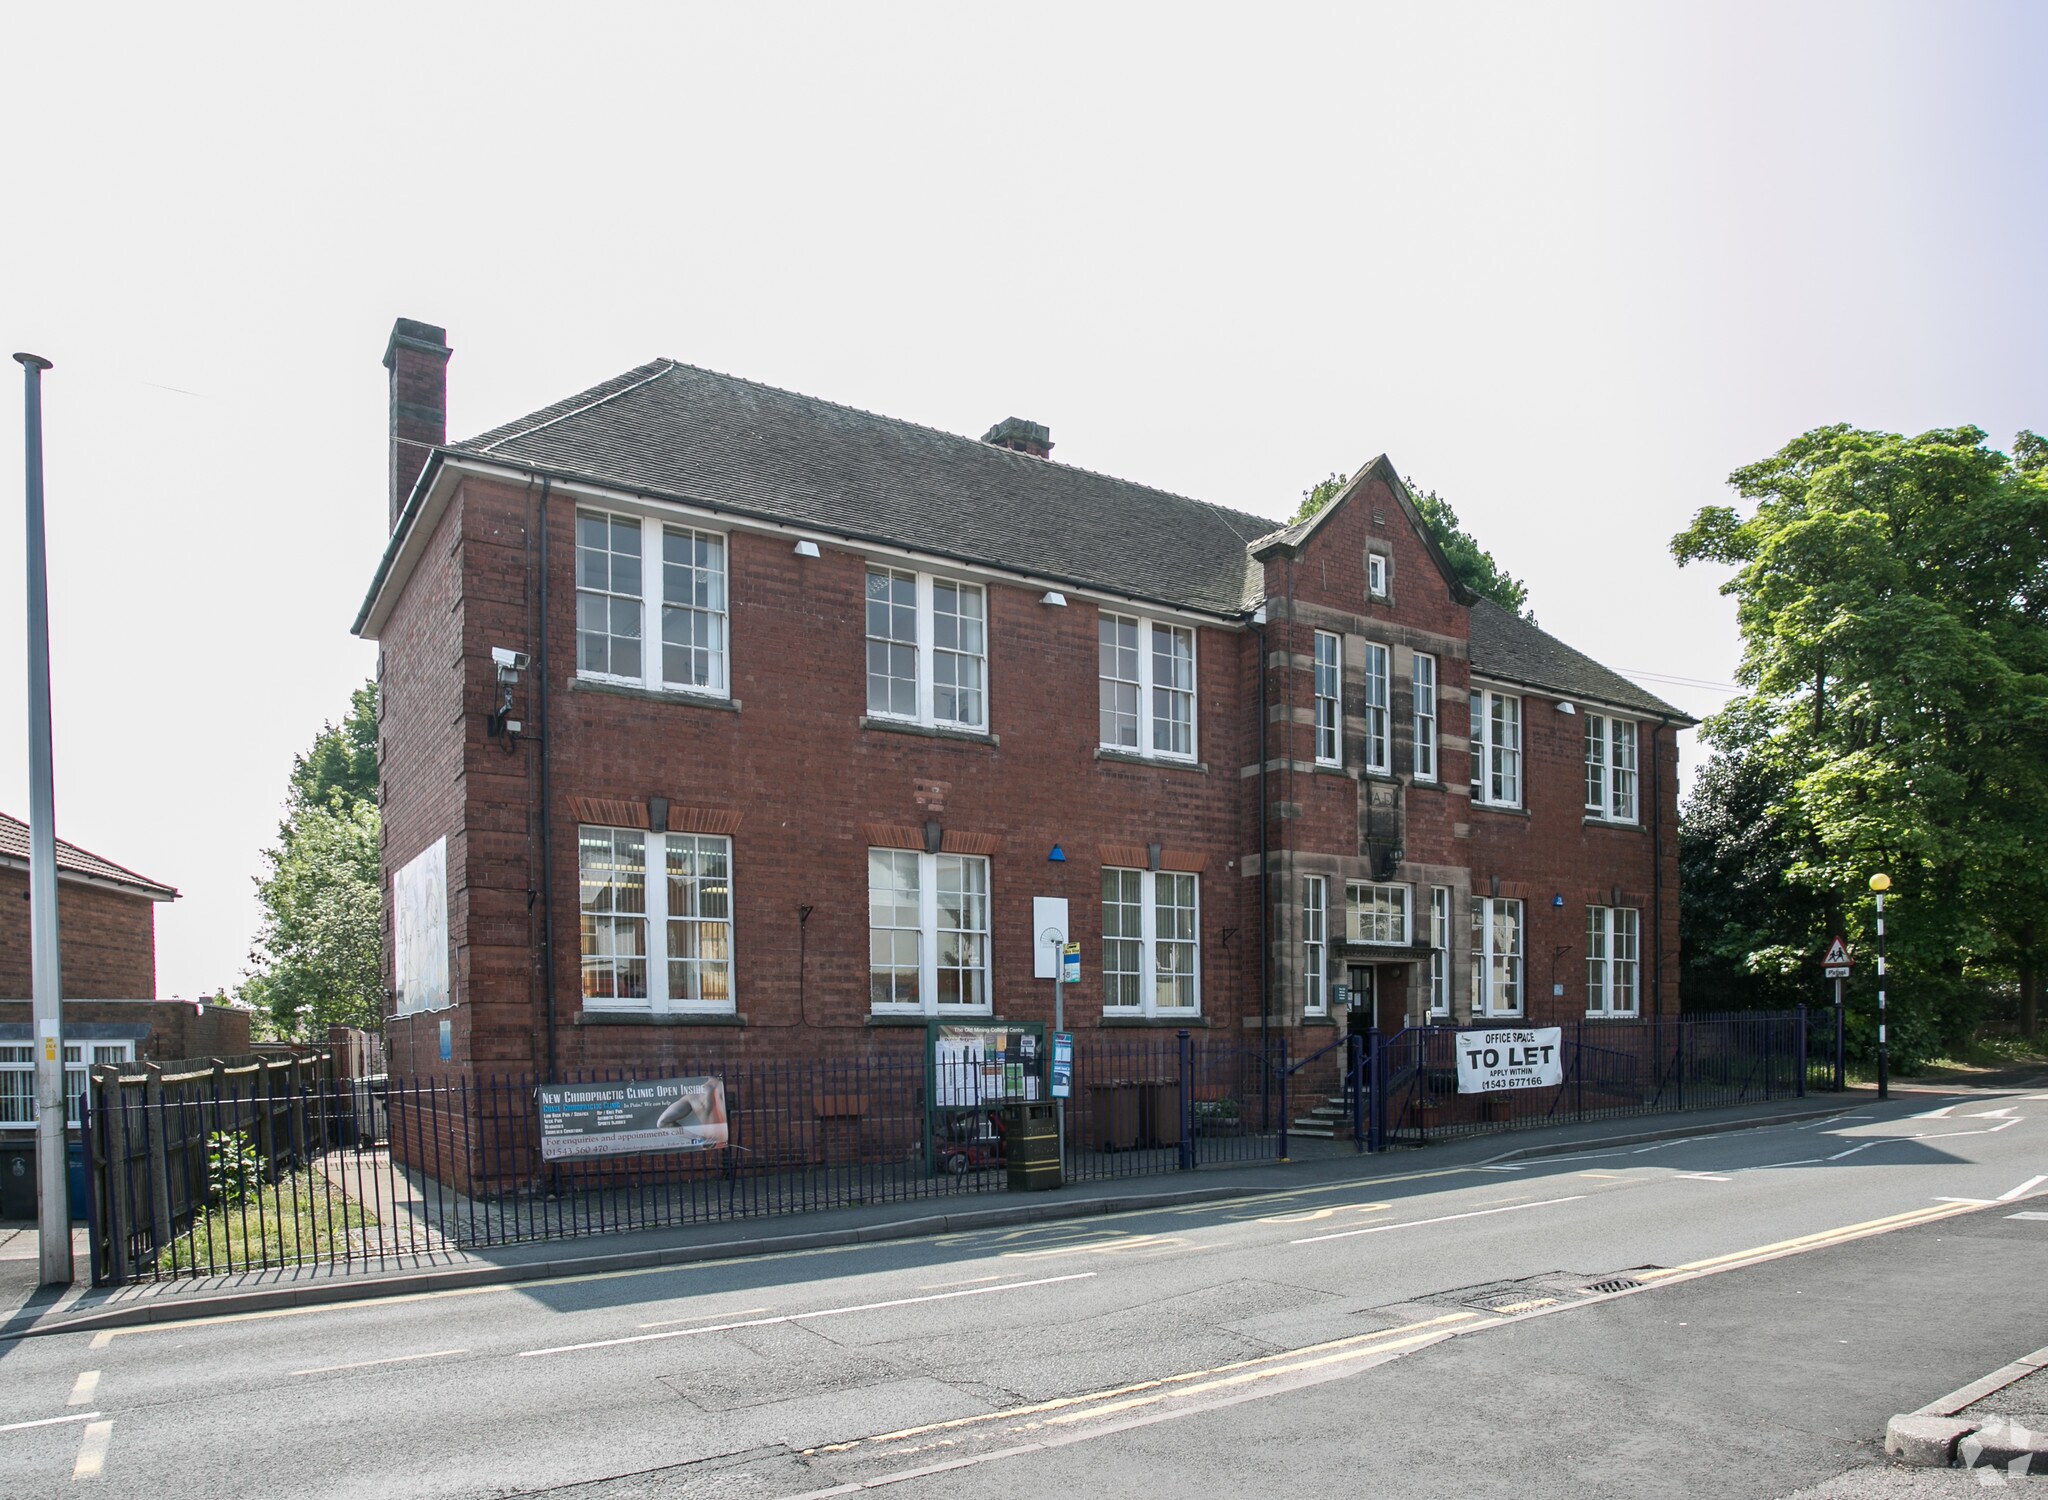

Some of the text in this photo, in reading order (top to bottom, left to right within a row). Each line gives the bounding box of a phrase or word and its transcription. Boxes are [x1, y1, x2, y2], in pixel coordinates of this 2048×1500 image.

[1486, 1032, 1535, 1044] OFFICE SPACE
[1466, 1046, 1554, 1070] TO LET
[1490, 1068, 1532, 1077] APPLY WITHIN
[1509, 1077, 1542, 1087] 677166
[546, 1128, 684, 1147] For enquiries and appointments call
[546, 1148, 573, 1156] 01543
[575, 1146, 591, 1154] 560
